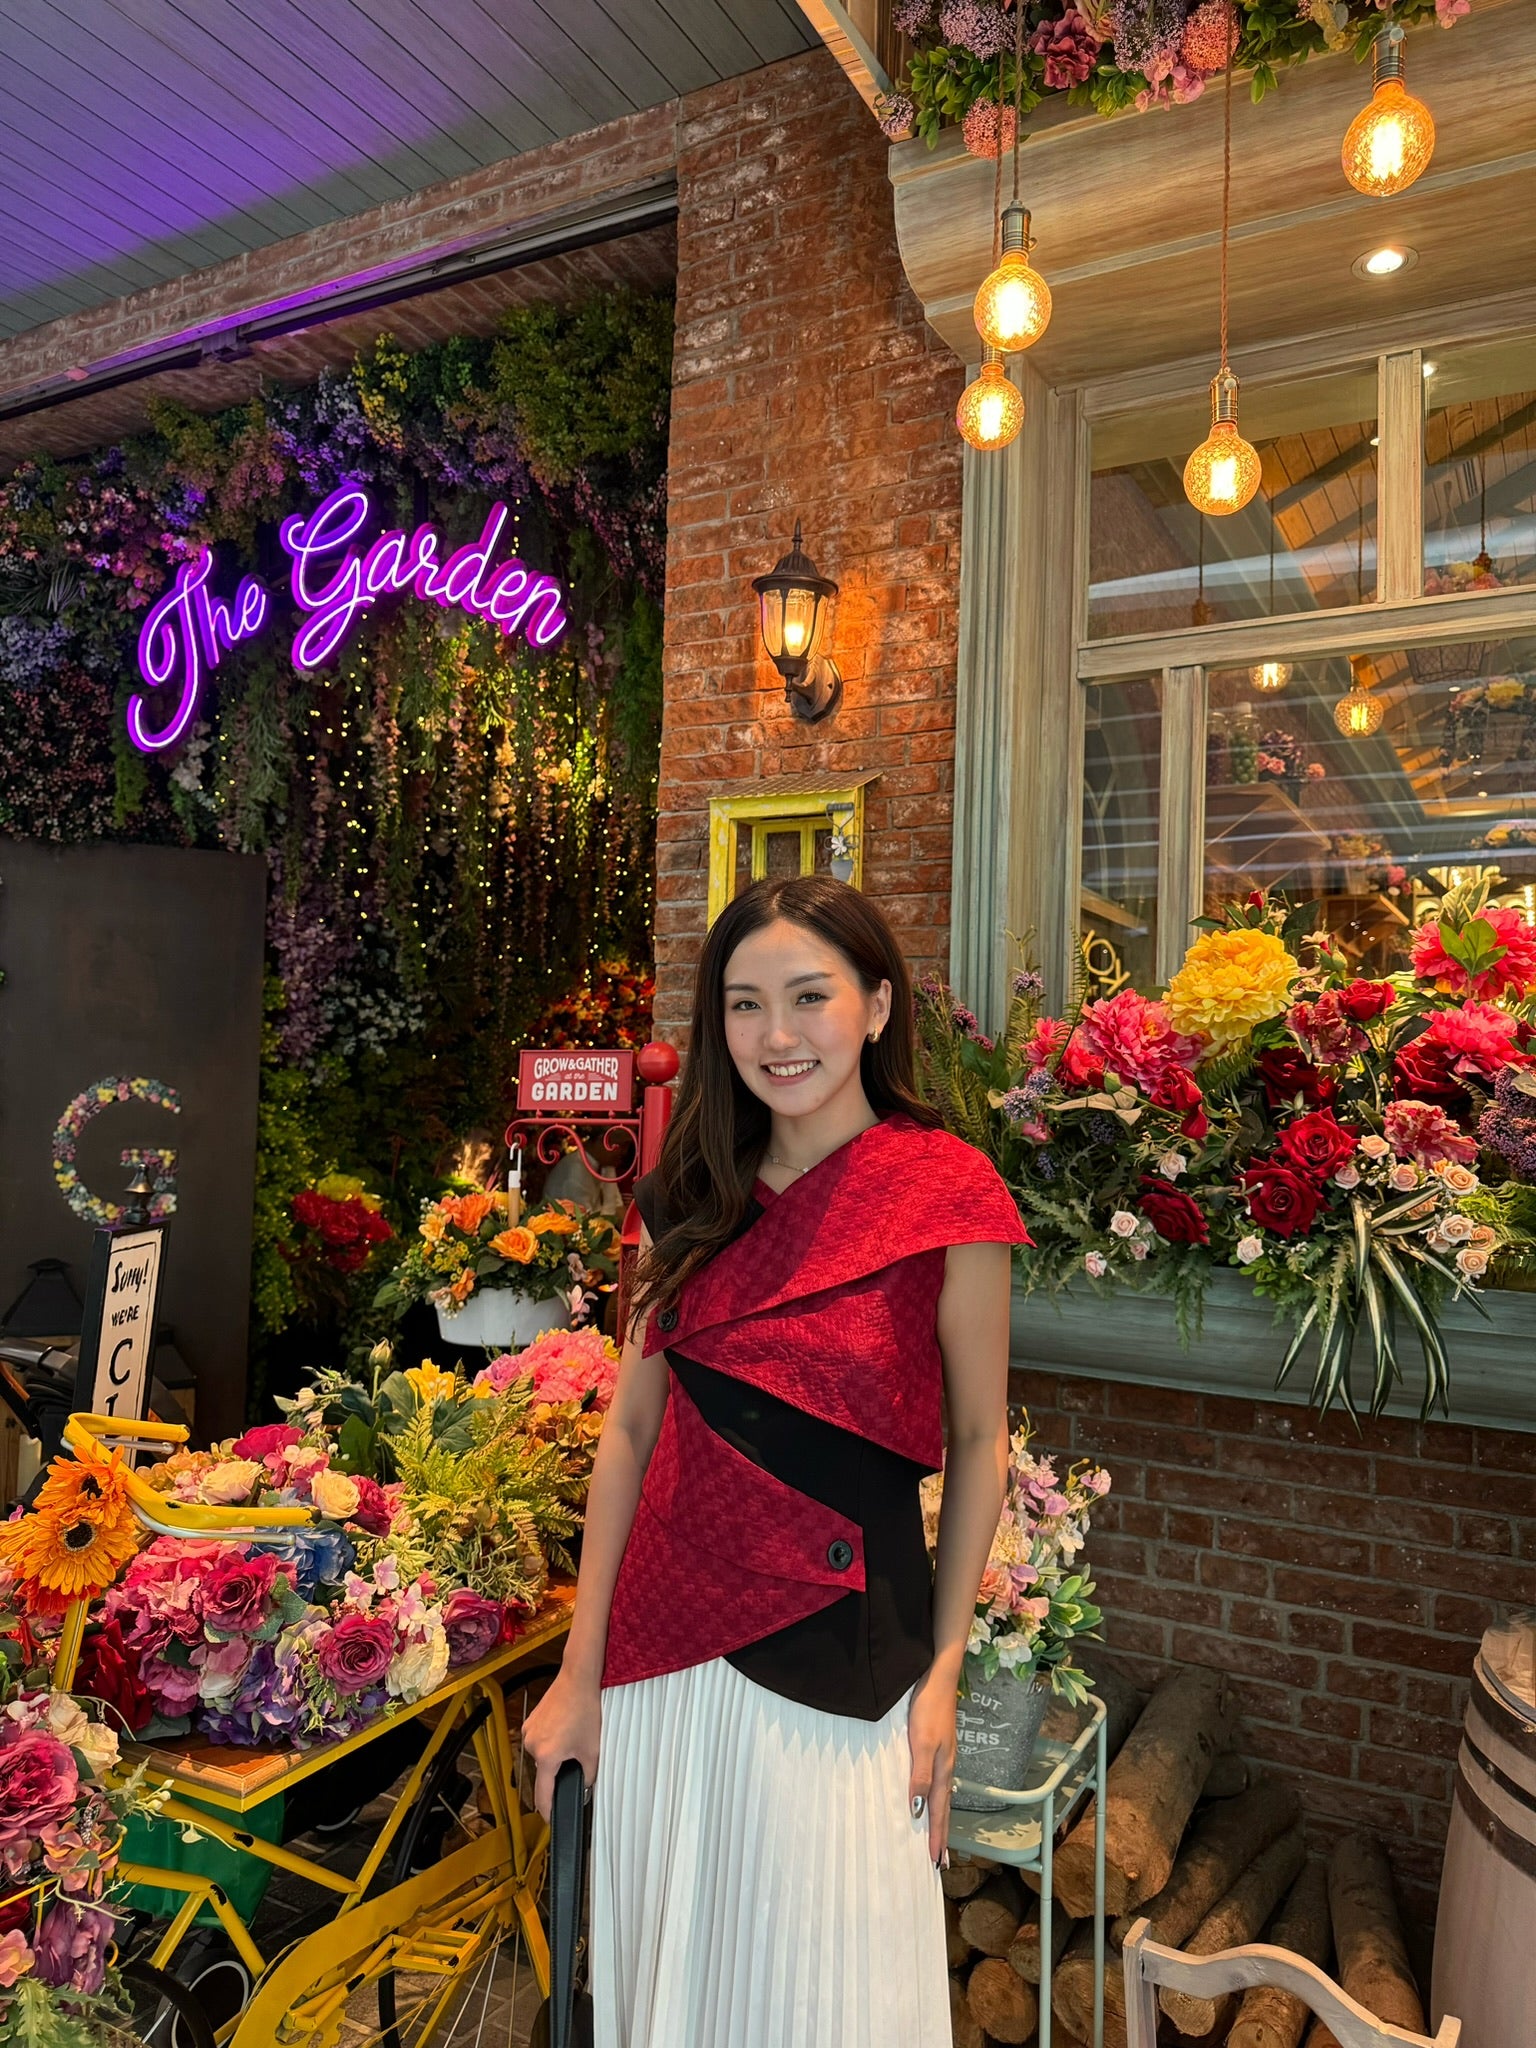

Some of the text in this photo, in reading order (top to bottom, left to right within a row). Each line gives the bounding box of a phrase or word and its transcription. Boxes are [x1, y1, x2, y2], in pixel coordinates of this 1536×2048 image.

[127, 484, 568, 752] The Garden
[531, 1082, 618, 1101] GARDEN
[111, 1258, 149, 1294] Sorry!
[111, 1305, 140, 1327] WE'RE
[970, 1691, 1003, 1711] CUT
